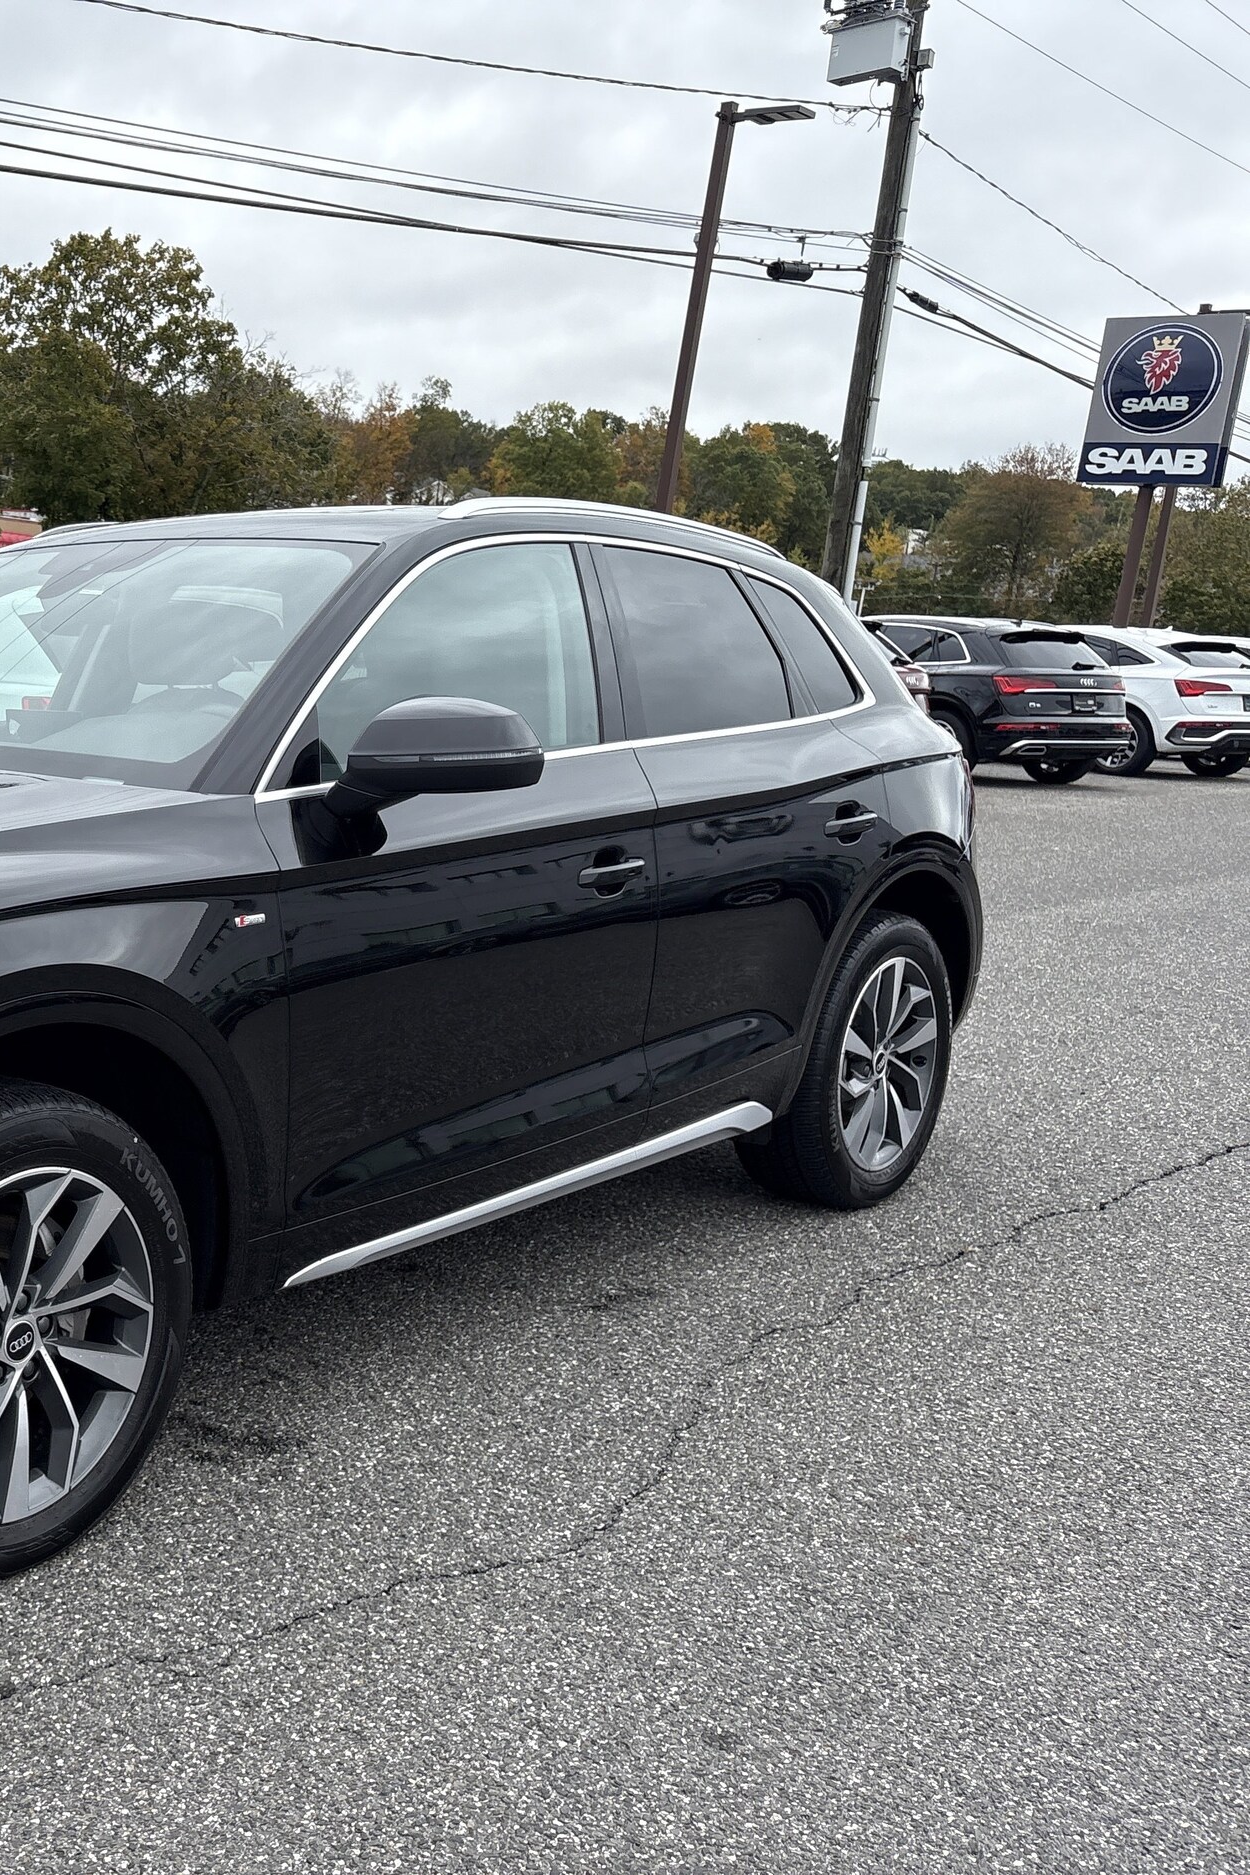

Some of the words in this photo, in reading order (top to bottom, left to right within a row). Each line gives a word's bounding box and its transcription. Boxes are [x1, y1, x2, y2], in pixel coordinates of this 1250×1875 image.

[1121, 395, 1190, 414] SAAB
[1085, 447, 1208, 475] SAAB
[120, 1146, 178, 1242] KUMHO
